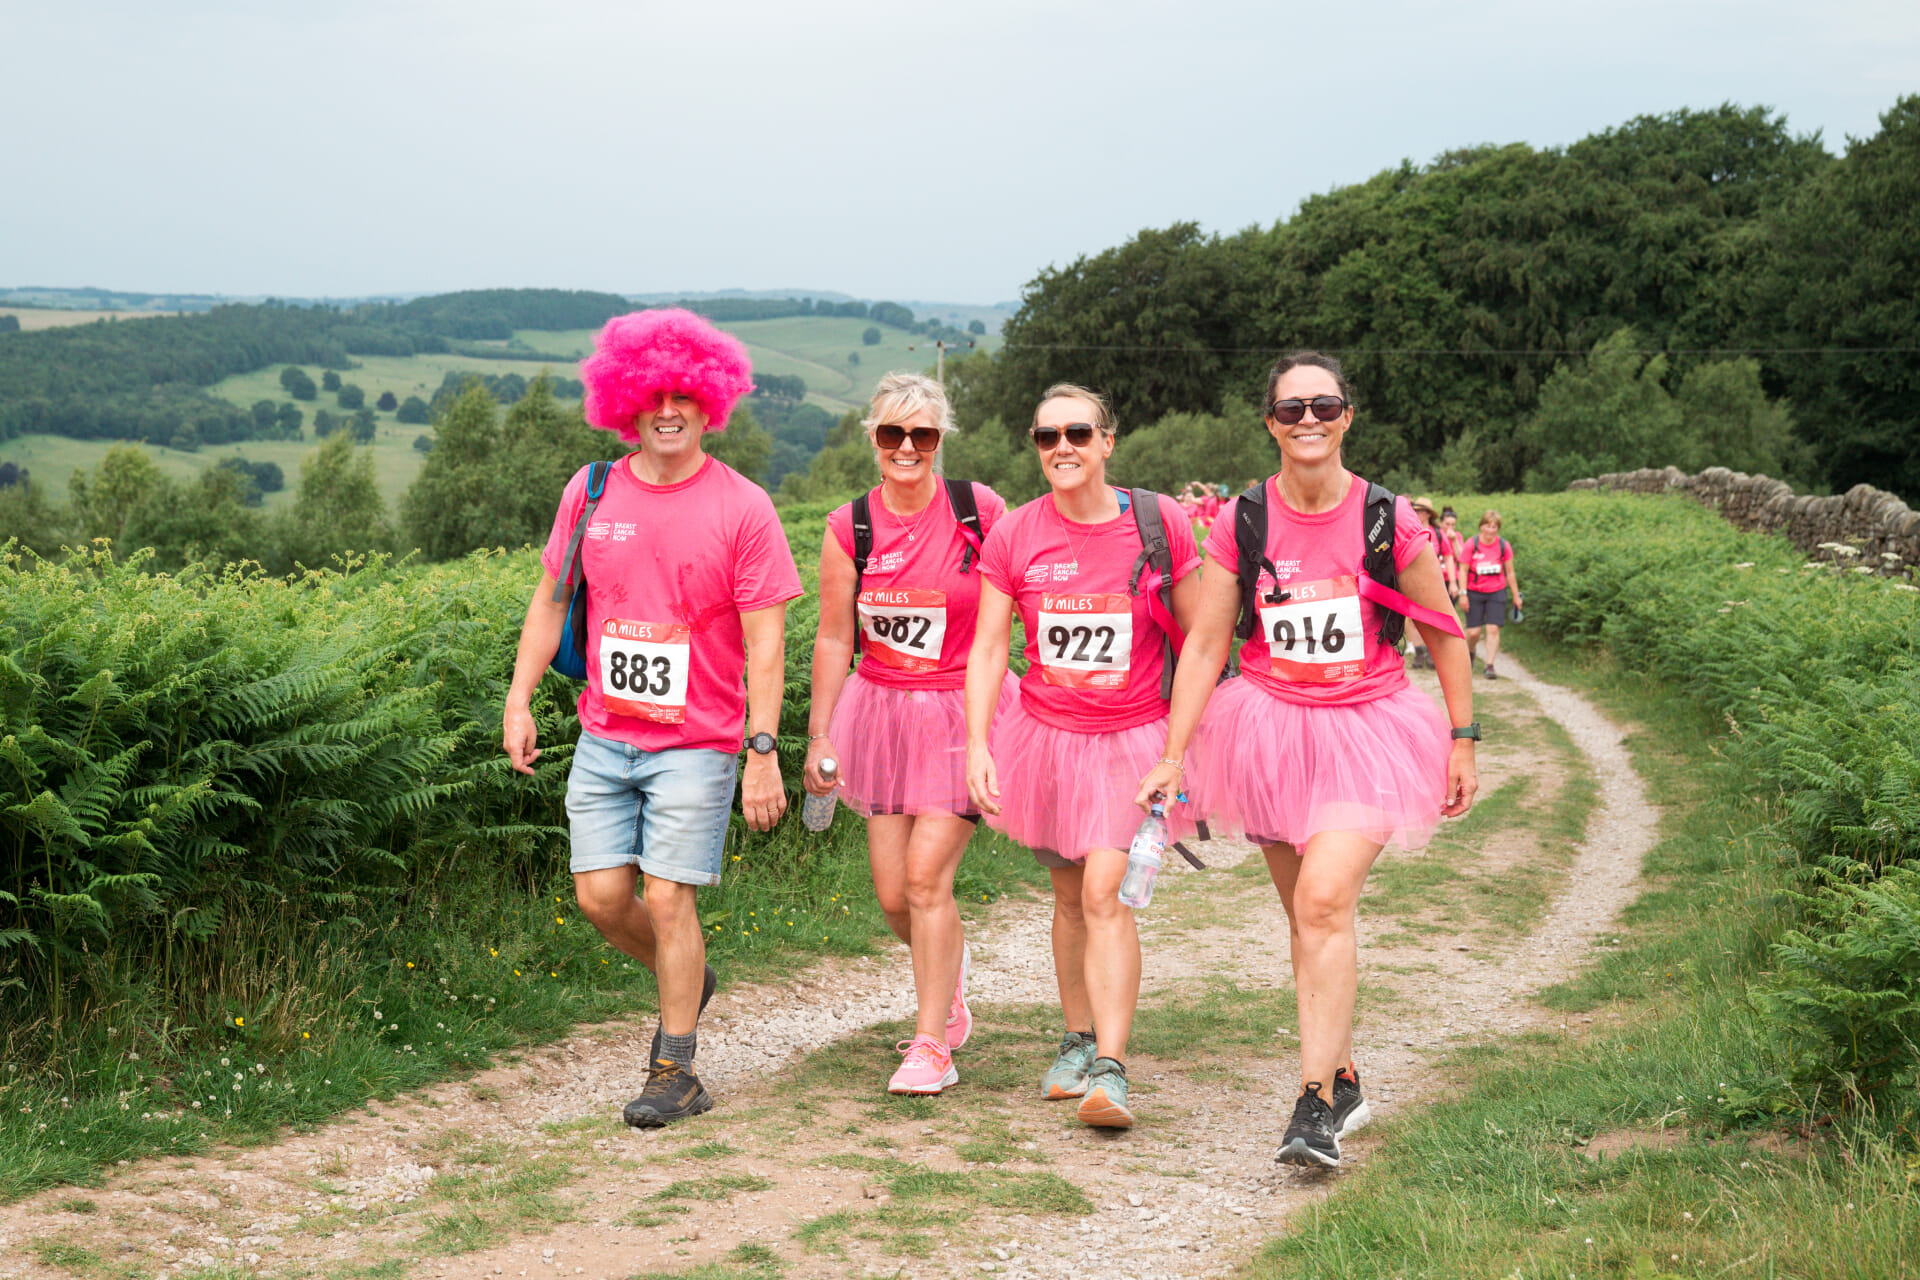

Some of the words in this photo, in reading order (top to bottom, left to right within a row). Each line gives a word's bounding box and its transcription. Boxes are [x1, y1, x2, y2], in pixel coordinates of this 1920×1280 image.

[881, 551, 904, 559] BREAST
[863, 591, 873, 602] 10
[875, 592, 909, 604] MILES
[1043, 597, 1053, 609] 10
[1055, 598, 1093, 611] MILES
[606, 621, 616, 634] 10
[618, 624, 652, 639] MILES
[871, 615, 932, 650] 882
[1273, 612, 1346, 655] 916
[1048, 625, 1116, 664] 922
[610, 650, 671, 696] 883
